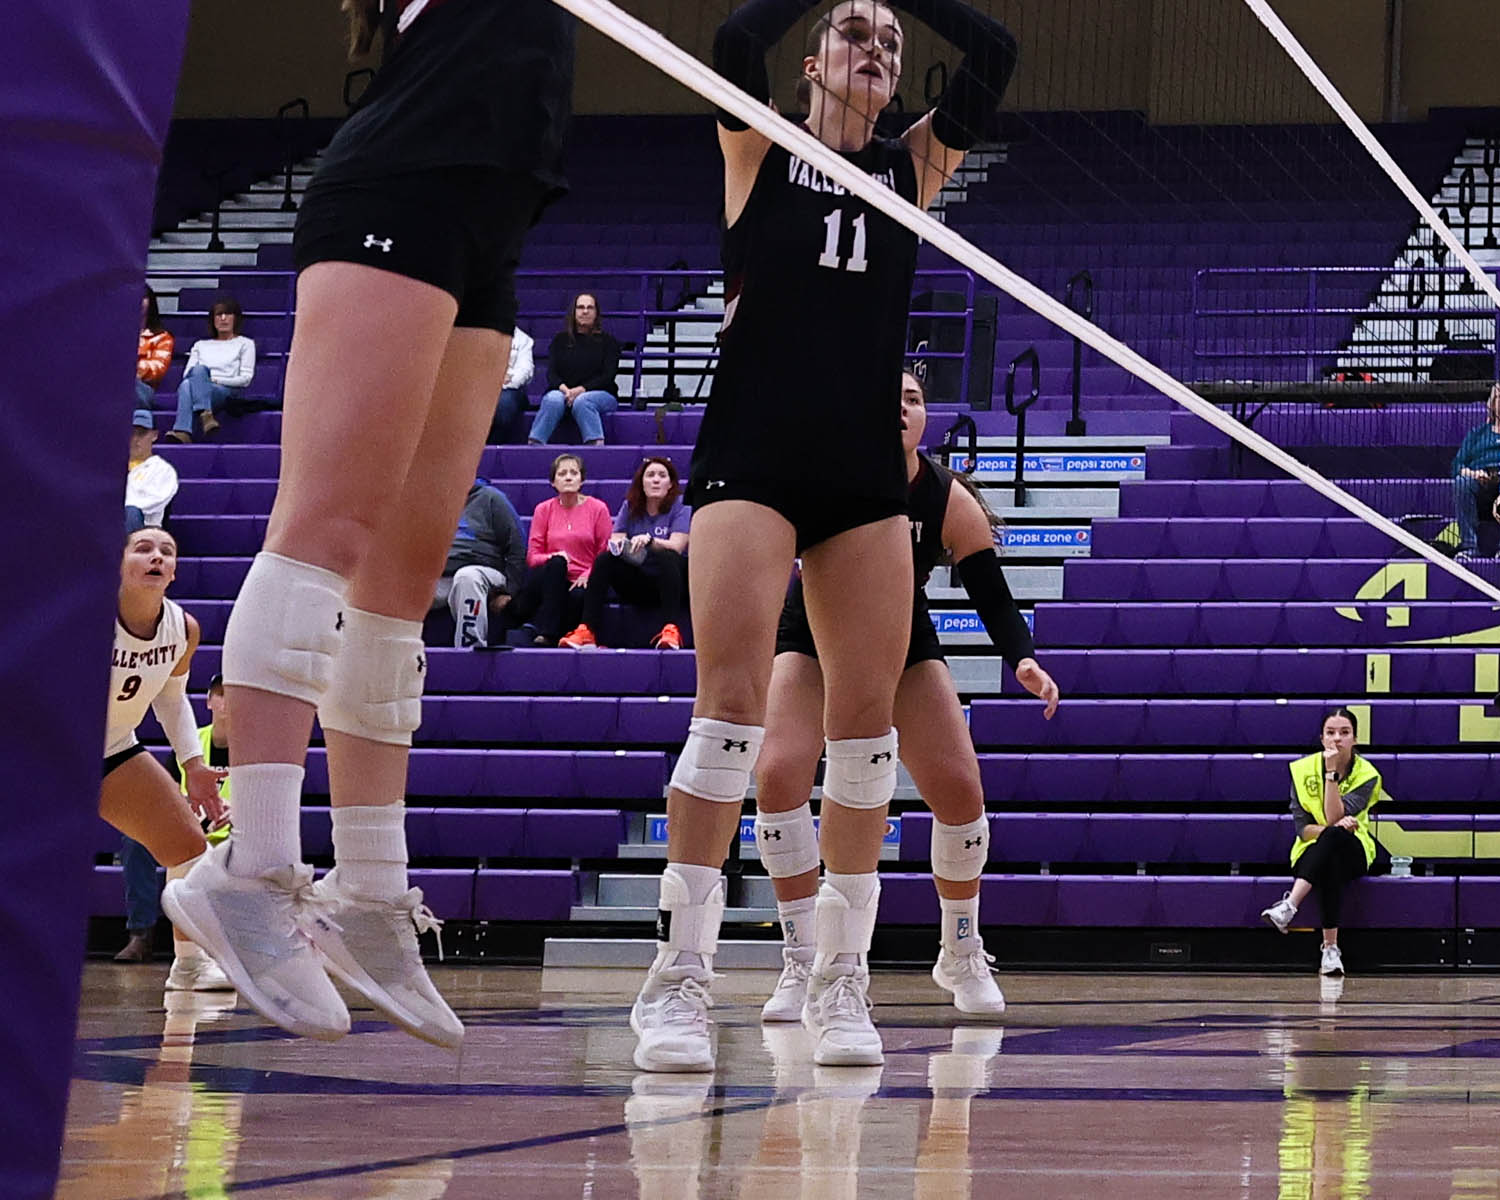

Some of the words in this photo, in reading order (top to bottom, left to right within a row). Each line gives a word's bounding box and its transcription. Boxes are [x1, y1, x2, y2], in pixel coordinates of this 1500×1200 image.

[818, 208, 868, 273] 11
[977, 459, 1008, 472] pepsi
[1011, 460, 1038, 470] zne
[1067, 459, 1098, 472] pepsi
[1100, 459, 1128, 469] zone
[1008, 532, 1041, 545] pepsi
[1043, 532, 1073, 543] zone
[462, 598, 481, 648] FILA
[943, 617, 979, 630] pepsi
[116, 674, 142, 702] 9
